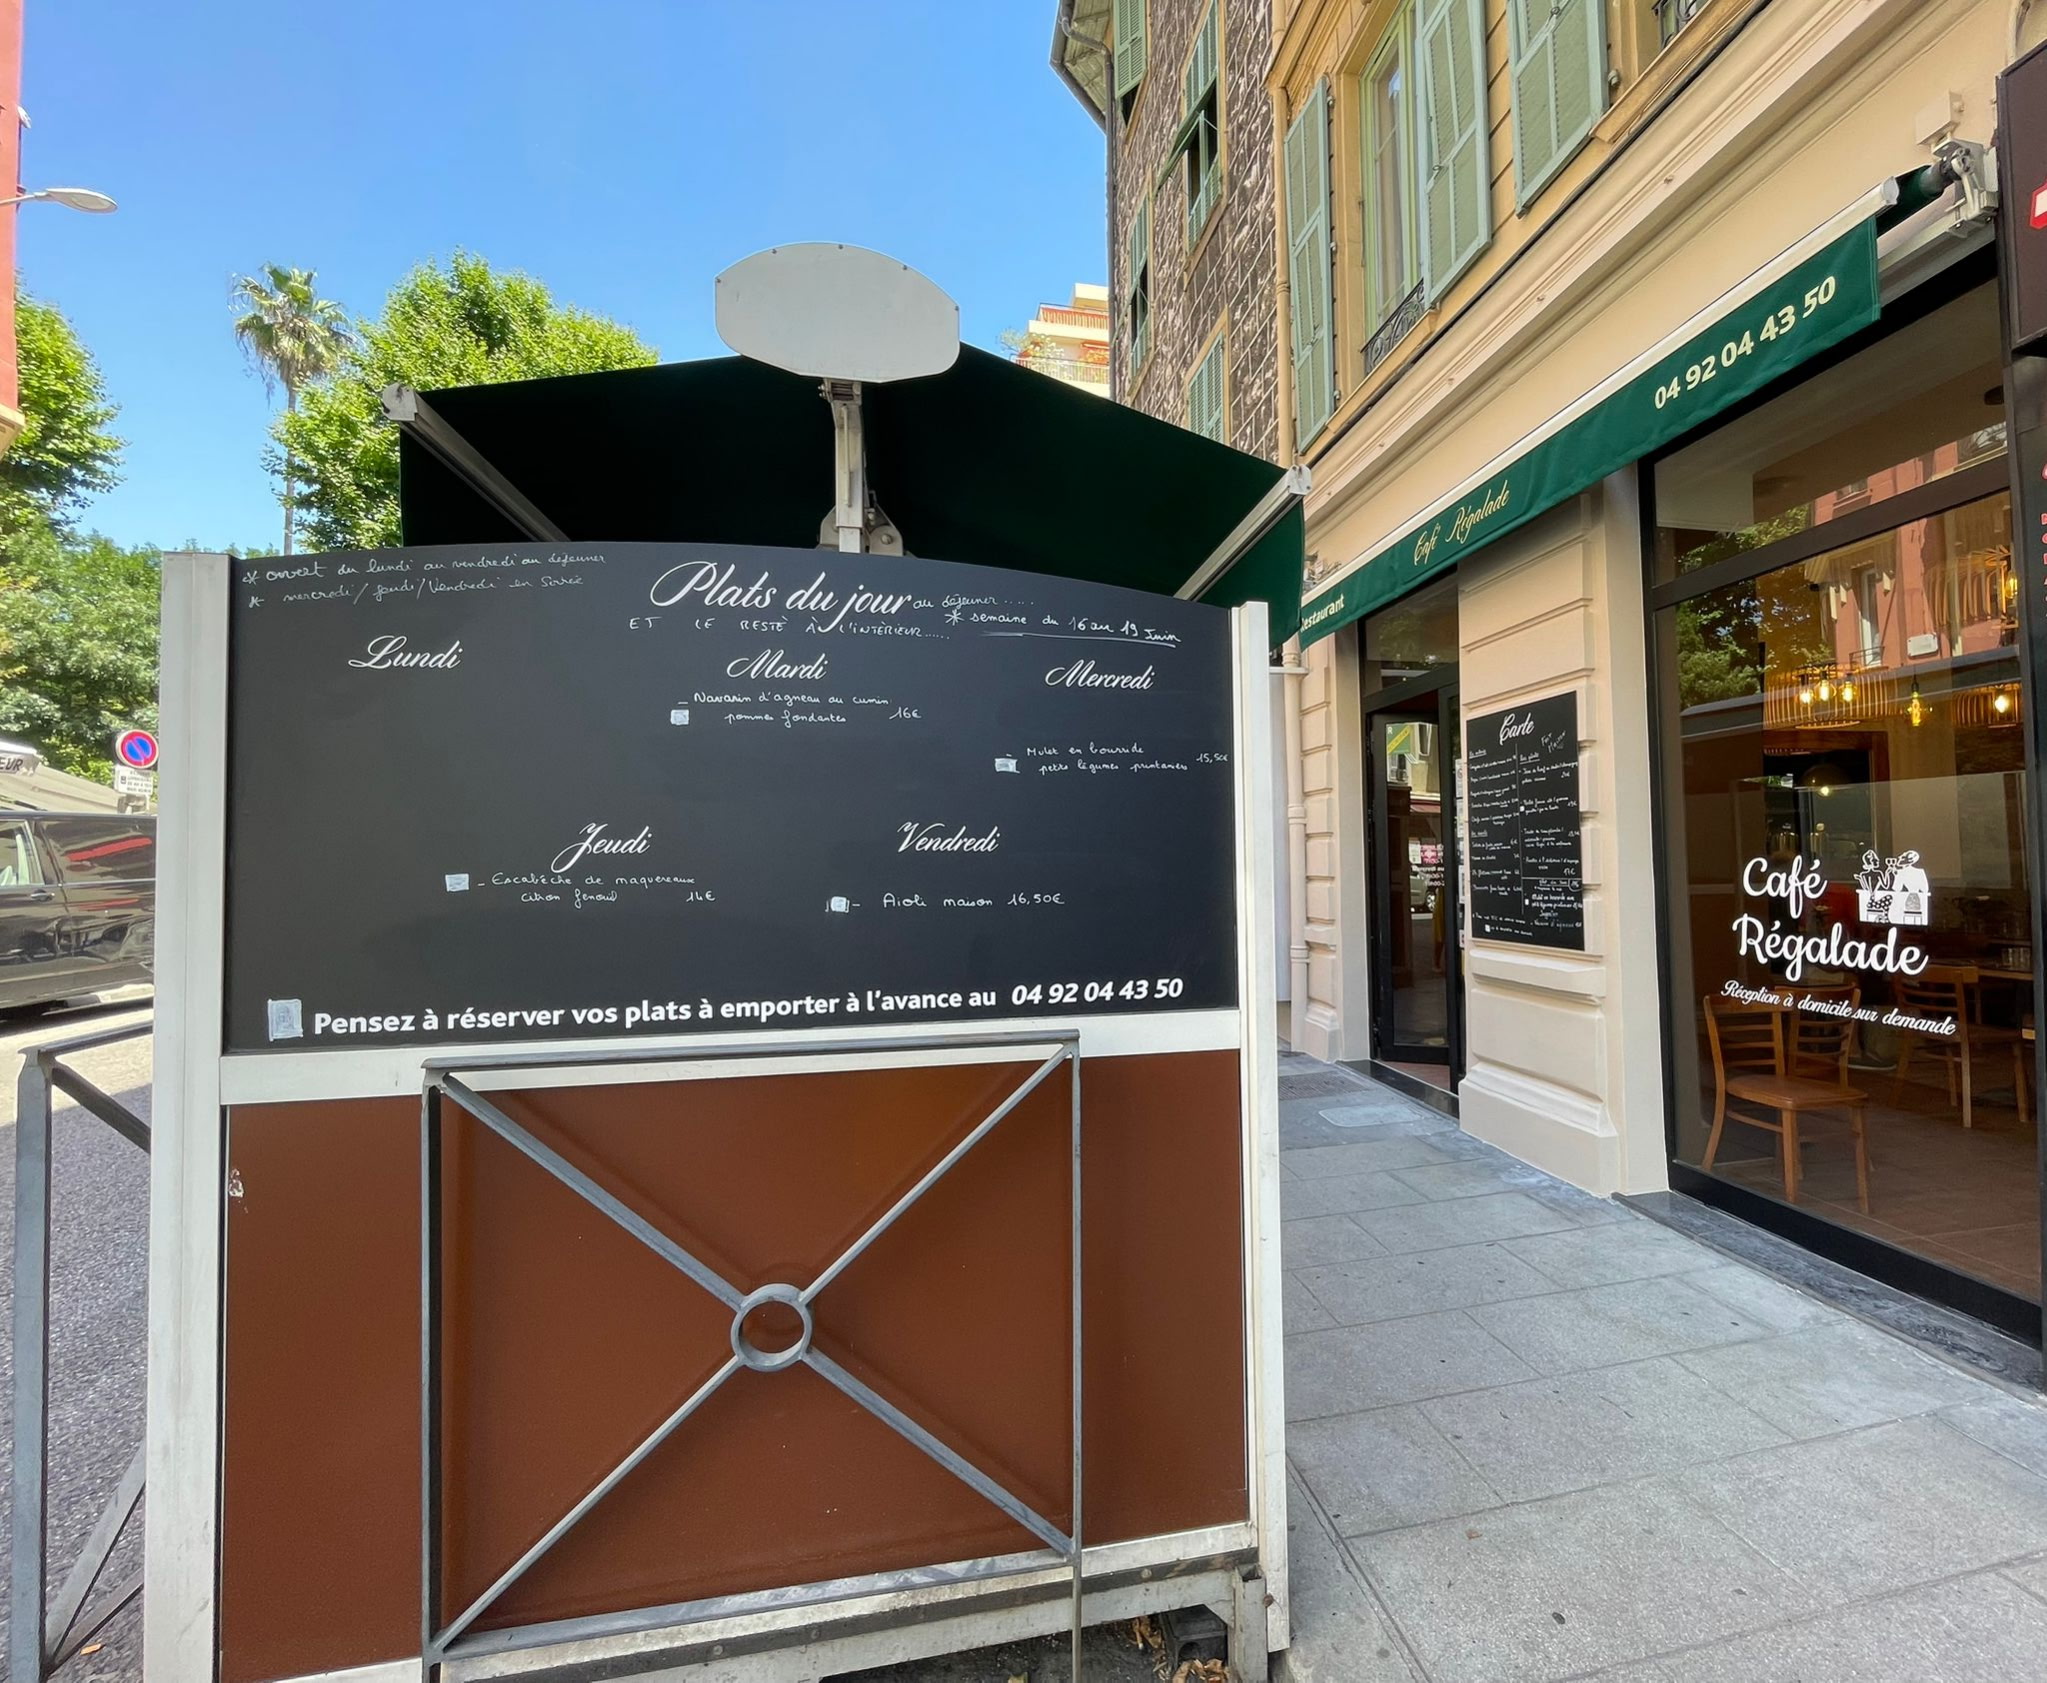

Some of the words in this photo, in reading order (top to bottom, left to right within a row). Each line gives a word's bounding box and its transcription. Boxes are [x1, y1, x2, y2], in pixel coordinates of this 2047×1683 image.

[1654, 376, 1681, 410] 04
[1685, 355, 1716, 391] 92
[1721, 330, 1754, 367] 04
[1759, 305, 1796, 342] 43
[1802, 276, 1836, 318] 50
[1414, 521, 1442, 566] Café
[1445, 480, 1511, 544] Régalade
[337, 565, 360, 576] du
[366, 559, 413, 575] lundi
[424, 560, 446, 571] au
[452, 553, 517, 570] vendredi
[521, 556, 539, 567] au
[650, 561, 778, 610] Plats
[786, 571, 839, 611] du
[818, 584, 912, 633] jour
[913, 598, 934, 609] au
[629, 616, 663, 630] ET
[969, 612, 1028, 625] semaine
[1042, 614, 1060, 626] du
[1069, 617, 1086, 631] 16
[1090, 622, 1114, 633] au
[1120, 620, 1138, 637] 19
[348, 635, 464, 670] Lundi
[726, 649, 829, 680] Mardi
[1044, 659, 1154, 690] Mercredi
[694, 692, 752, 703] Navarin
[758, 691, 821, 706] d'agneau
[852, 695, 890, 705] cumin
[889, 707, 922, 720] 16€
[1500, 712, 1535, 746] Carte
[1068, 747, 1083, 756] en
[550, 822, 652, 873] Jeudi
[897, 822, 1000, 853] Vendredi
[585, 874, 604, 885] de
[1742, 854, 1828, 919] Café
[521, 891, 561, 902] citron
[943, 897, 993, 907] maison
[1007, 893, 1065, 906] 16,50€
[1732, 913, 1929, 982] Régalade
[314, 1012, 415, 1035] Pensez
[422, 1009, 439, 1030] à
[447, 1006, 564, 1030] réserver
[571, 1004, 618, 1024] vos
[625, 999, 691, 1028] plats
[698, 998, 715, 1020] à
[721, 993, 839, 1022] emporter
[846, 991, 860, 1013] à
[866, 988, 962, 1012] l'avance
[969, 989, 996, 1007] au
[1011, 983, 1042, 1005] 04
[1047, 983, 1078, 1003] 92
[1084, 981, 1114, 1002] 04
[1118, 979, 1148, 1000] 43
[1154, 978, 1184, 999] 50
[1720, 980, 1780, 1006] Réception
[1783, 992, 1794, 1007] à
[1797, 994, 1851, 1018] domicile
[1851, 1008, 1878, 1022] sur
[1882, 1008, 1956, 1035] demande
